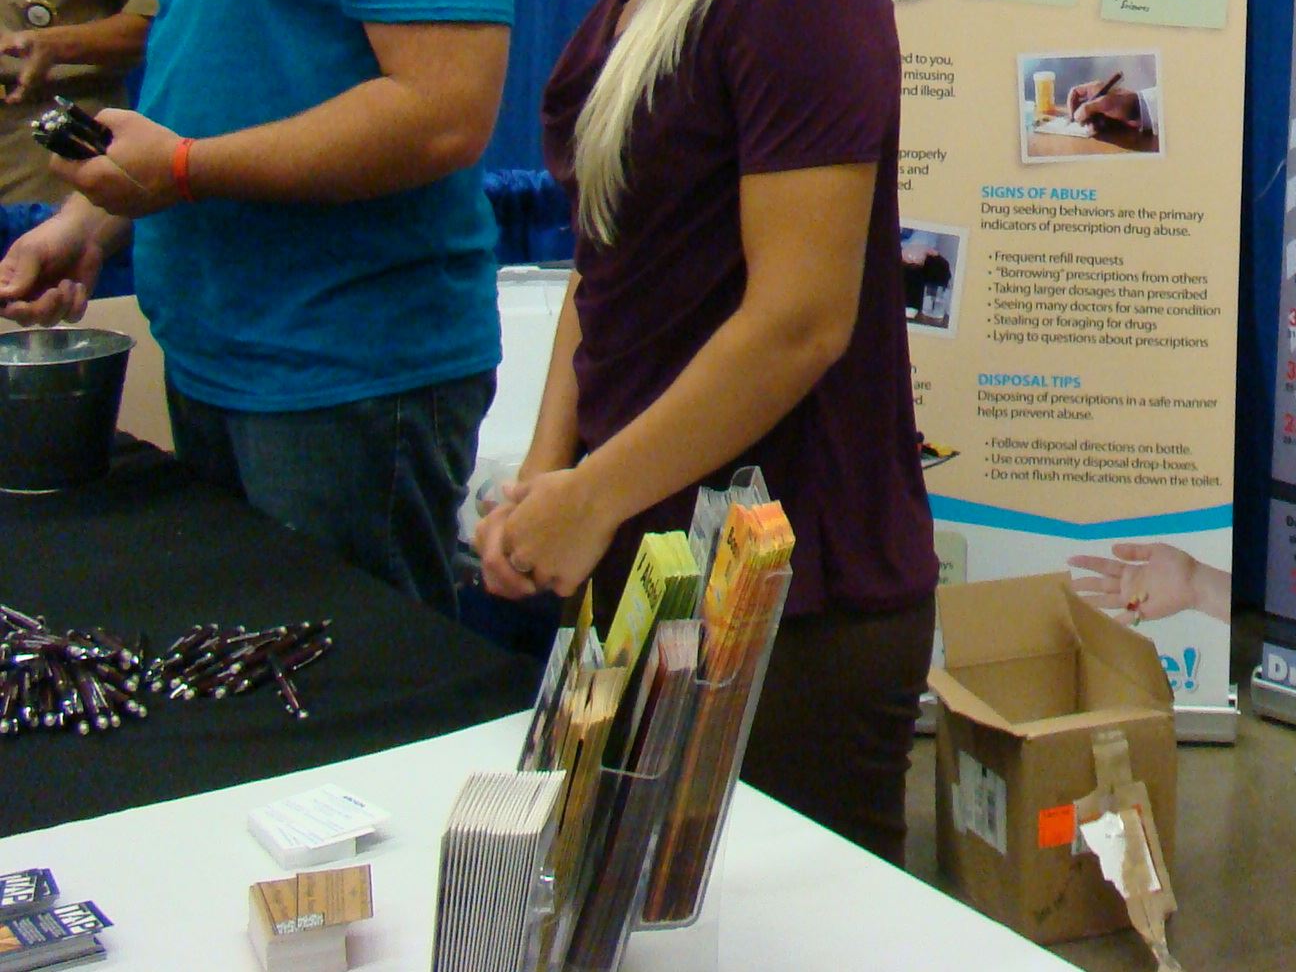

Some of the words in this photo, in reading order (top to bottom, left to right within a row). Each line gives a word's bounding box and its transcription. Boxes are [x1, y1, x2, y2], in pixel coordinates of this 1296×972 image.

[982, 186, 1025, 198] SIGNS
[1028, 187, 1046, 199] OF
[1050, 188, 1097, 200] ABUSE
